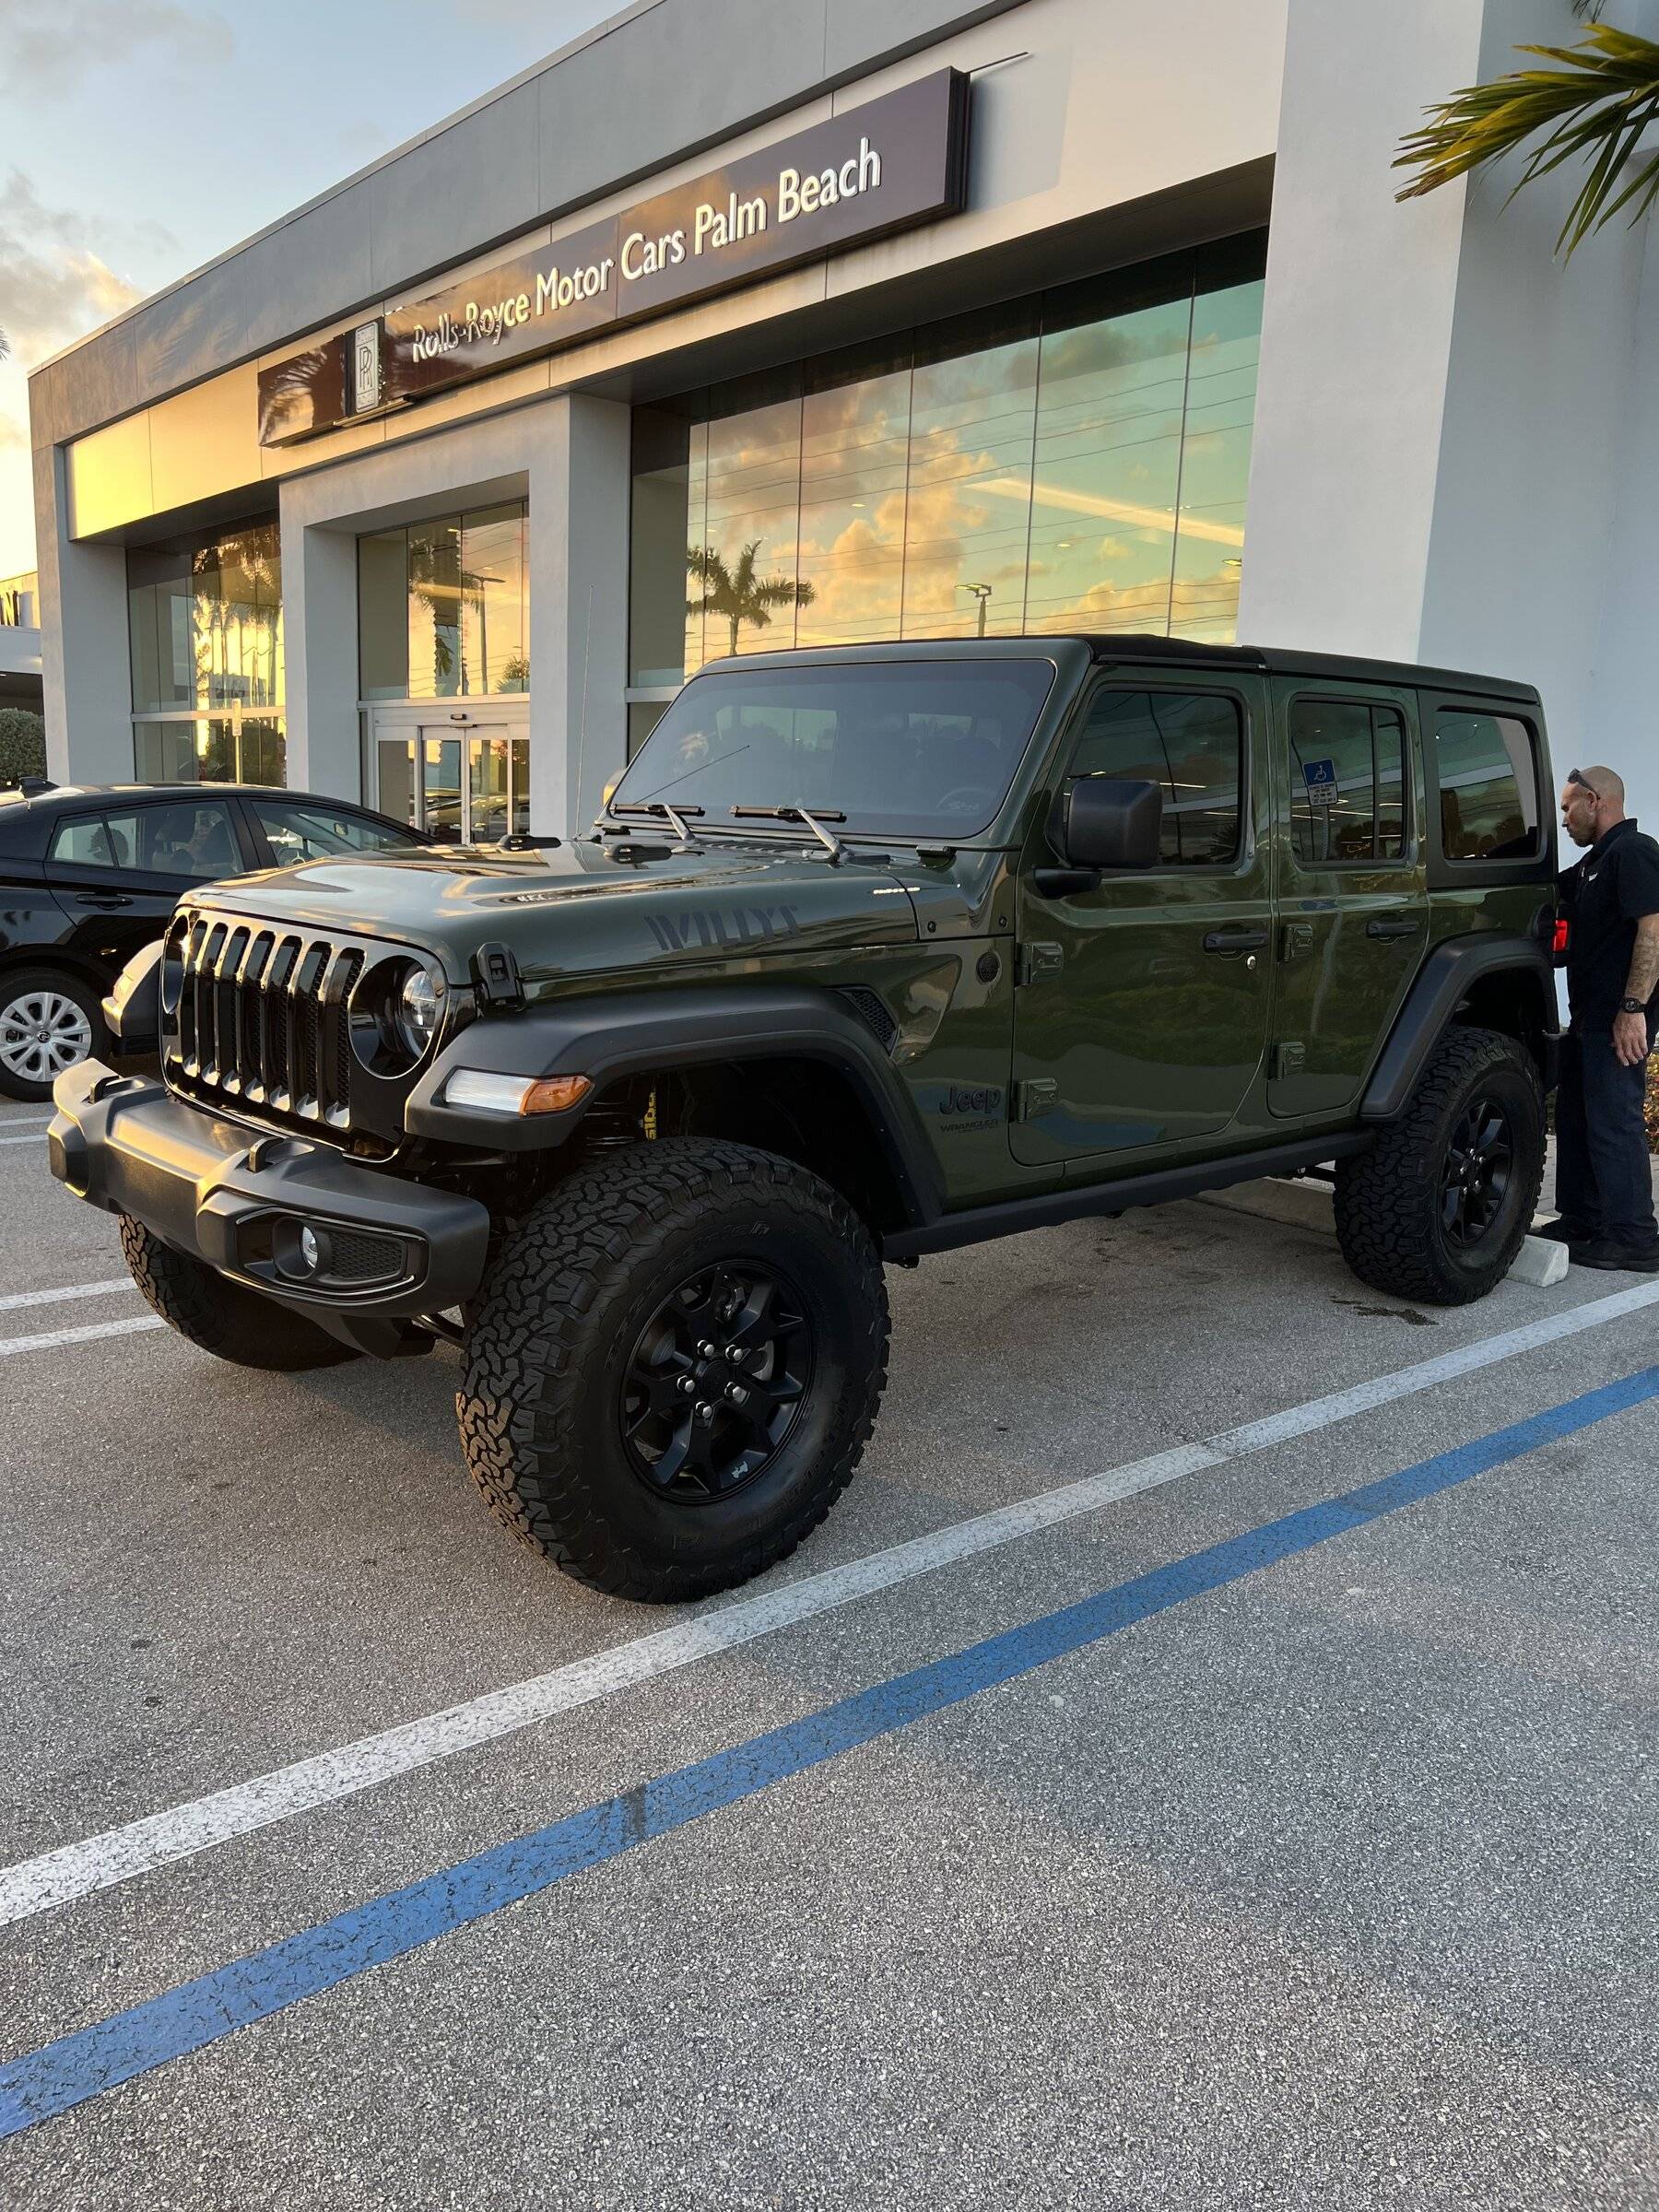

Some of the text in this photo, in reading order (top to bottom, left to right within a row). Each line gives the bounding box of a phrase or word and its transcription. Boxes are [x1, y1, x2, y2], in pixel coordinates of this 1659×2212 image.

[413, 136, 881, 363] Rolls-Royce Motor Cars Palm Beach
[643, 905, 799, 951] WILLYS
[939, 1086, 1002, 1115] Jeep
